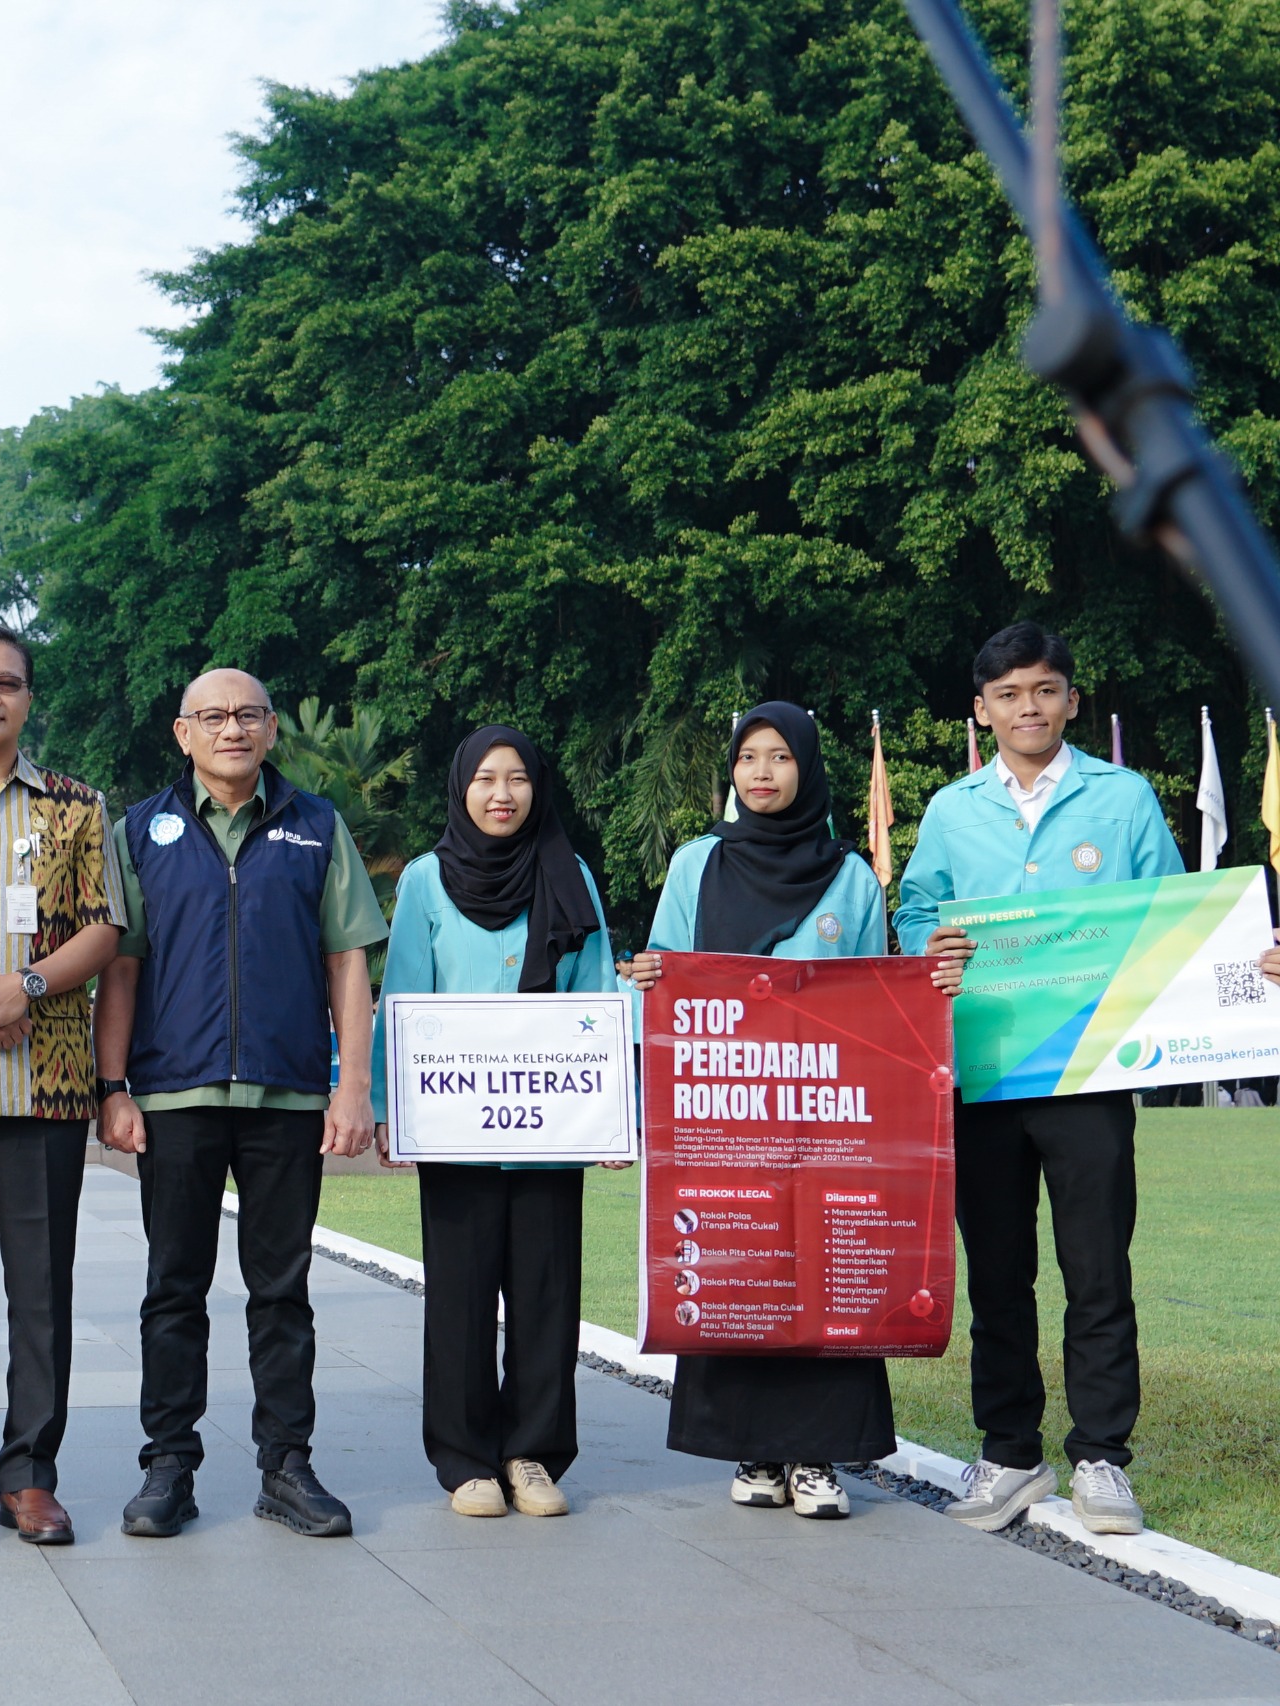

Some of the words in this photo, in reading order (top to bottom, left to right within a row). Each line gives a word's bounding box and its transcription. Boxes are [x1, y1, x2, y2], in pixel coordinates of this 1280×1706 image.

[951, 915, 986, 927] KARTU
[989, 909, 1036, 922] PESERTA
[993, 937, 1020, 950] 1118
[1024, 932, 1064, 946] XXXX
[1069, 927, 1110, 941] XXXX
[1029, 972, 1109, 988] ARYADHARMA
[673, 998, 744, 1035] STOP
[1168, 1036, 1213, 1053] BPJS
[413, 1053, 455, 1064] SERAH
[459, 1053, 509, 1064] TERIMA
[513, 1052, 608, 1063] KELENGKAPAN
[674, 1041, 838, 1079] PEREDARAN
[1170, 1047, 1279, 1065] Ketenagakerjaan
[420, 1071, 476, 1094] KKN
[487, 1070, 602, 1094] LITERASI
[674, 1083, 769, 1121] ROKOK
[777, 1085, 873, 1122] ILEGAL
[481, 1105, 544, 1130] 2025
[674, 1135, 735, 1144] Undang-Undang
[812, 1138, 842, 1146] tentang
[674, 1144, 723, 1152] sebagaimana
[746, 1145, 782, 1153] beberapa
[674, 1152, 702, 1160] dengan
[703, 1152, 765, 1161] Undang-Undang
[841, 1155, 872, 1163] tentang
[760, 1161, 801, 1169] Perpajakan
[678, 1189, 697, 1197] CIRI
[699, 1189, 735, 1198] ROKOK
[737, 1189, 772, 1198] ILEGAL
[825, 1193, 867, 1204] Dilarang
[869, 1194, 877, 1202] !!!
[700, 1212, 726, 1220] Rokok
[728, 1212, 751, 1220] Polos
[832, 1208, 887, 1217] Menawarkan
[701, 1222, 731, 1230] (Tanpa
[733, 1222, 749, 1230] Pita
[751, 1222, 779, 1231] Cukai)
[832, 1219, 889, 1228] Menyediakan
[891, 1219, 916, 1227] untuk
[832, 1228, 856, 1236] Dijual
[832, 1237, 866, 1246] Menjual
[729, 1249, 745, 1257] Pita
[747, 1249, 772, 1257] Cukai
[832, 1247, 895, 1256] Menyerahkan/
[832, 1257, 887, 1265] Memberikan
[832, 1267, 888, 1276] Memperoleh
[701, 1278, 727, 1286] Rokok
[747, 1279, 771, 1287] Cukai
[773, 1279, 796, 1287] Bekas
[832, 1286, 887, 1296] Menyimpan/
[832, 1296, 879, 1304] Menimbun
[701, 1302, 727, 1310] Rokok
[729, 1303, 761, 1312] dengan
[763, 1303, 779, 1311] Pita
[832, 1306, 870, 1314] Menukar
[701, 1312, 727, 1320] Bukan
[729, 1313, 792, 1322] Peruntukannya
[722, 1322, 745, 1330] Tidak
[746, 1322, 774, 1330] Sesuai
[700, 1331, 764, 1340] Peruntukannya
[826, 1327, 859, 1335] Sanksi
